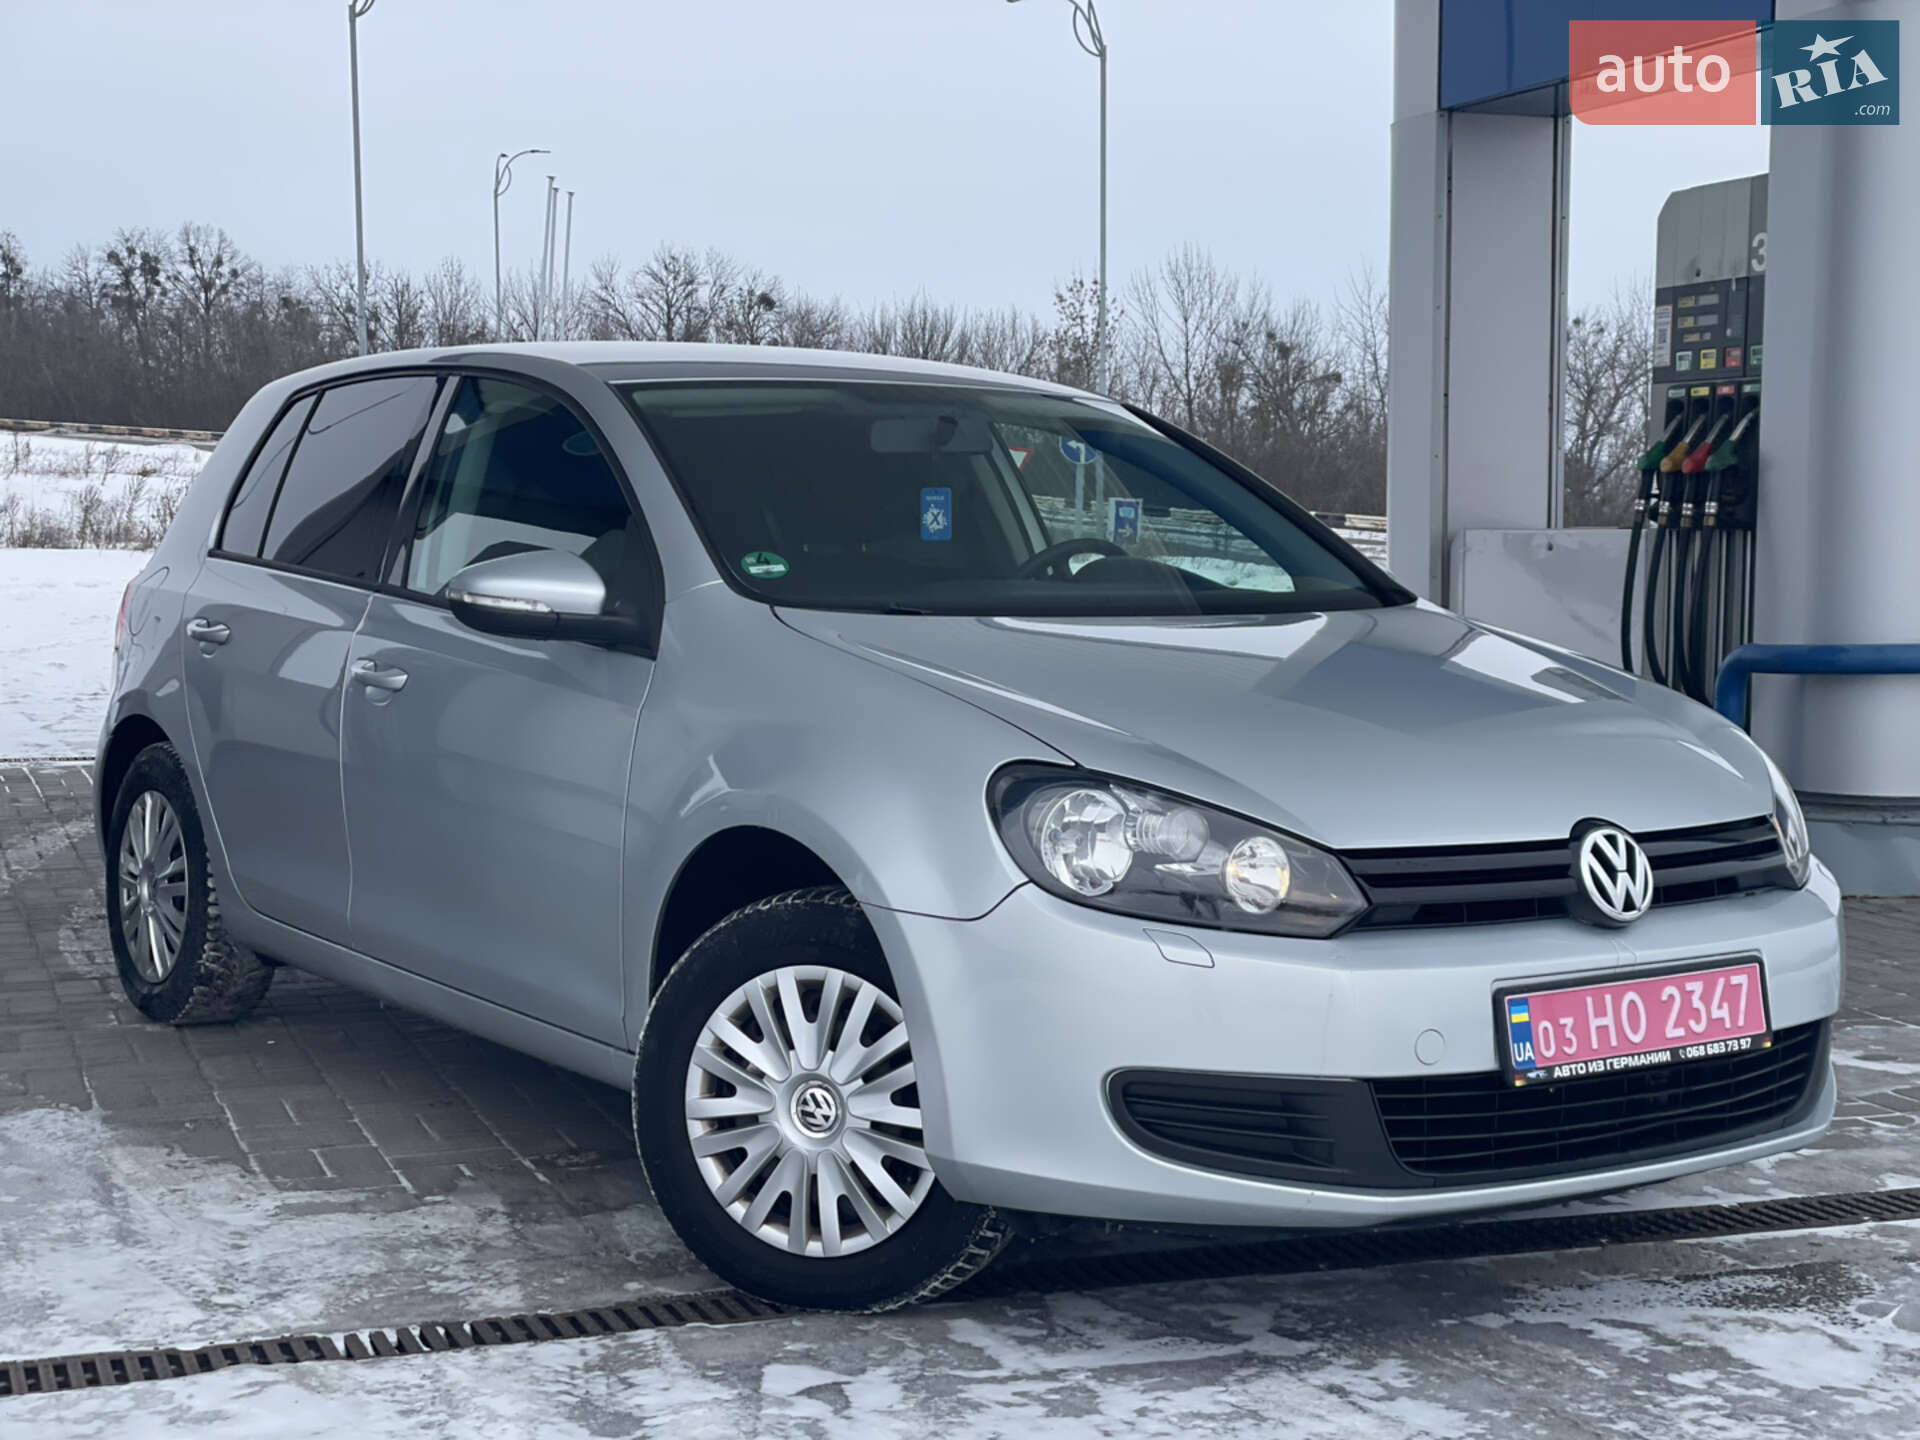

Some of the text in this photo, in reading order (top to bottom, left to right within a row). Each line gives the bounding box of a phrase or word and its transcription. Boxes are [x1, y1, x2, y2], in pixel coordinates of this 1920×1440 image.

[1751, 232, 1767, 272] 3
[1537, 974, 1750, 1058] 03 HO 2347
[1513, 1043, 1535, 1063] UA
[1686, 1044, 1705, 1058] 068
[1726, 1039, 1739, 1052] 73
[1739, 1037, 1752, 1049] 97
[1553, 1050, 1671, 1078] АВТО ИЗ ГЕРМАНИИ
